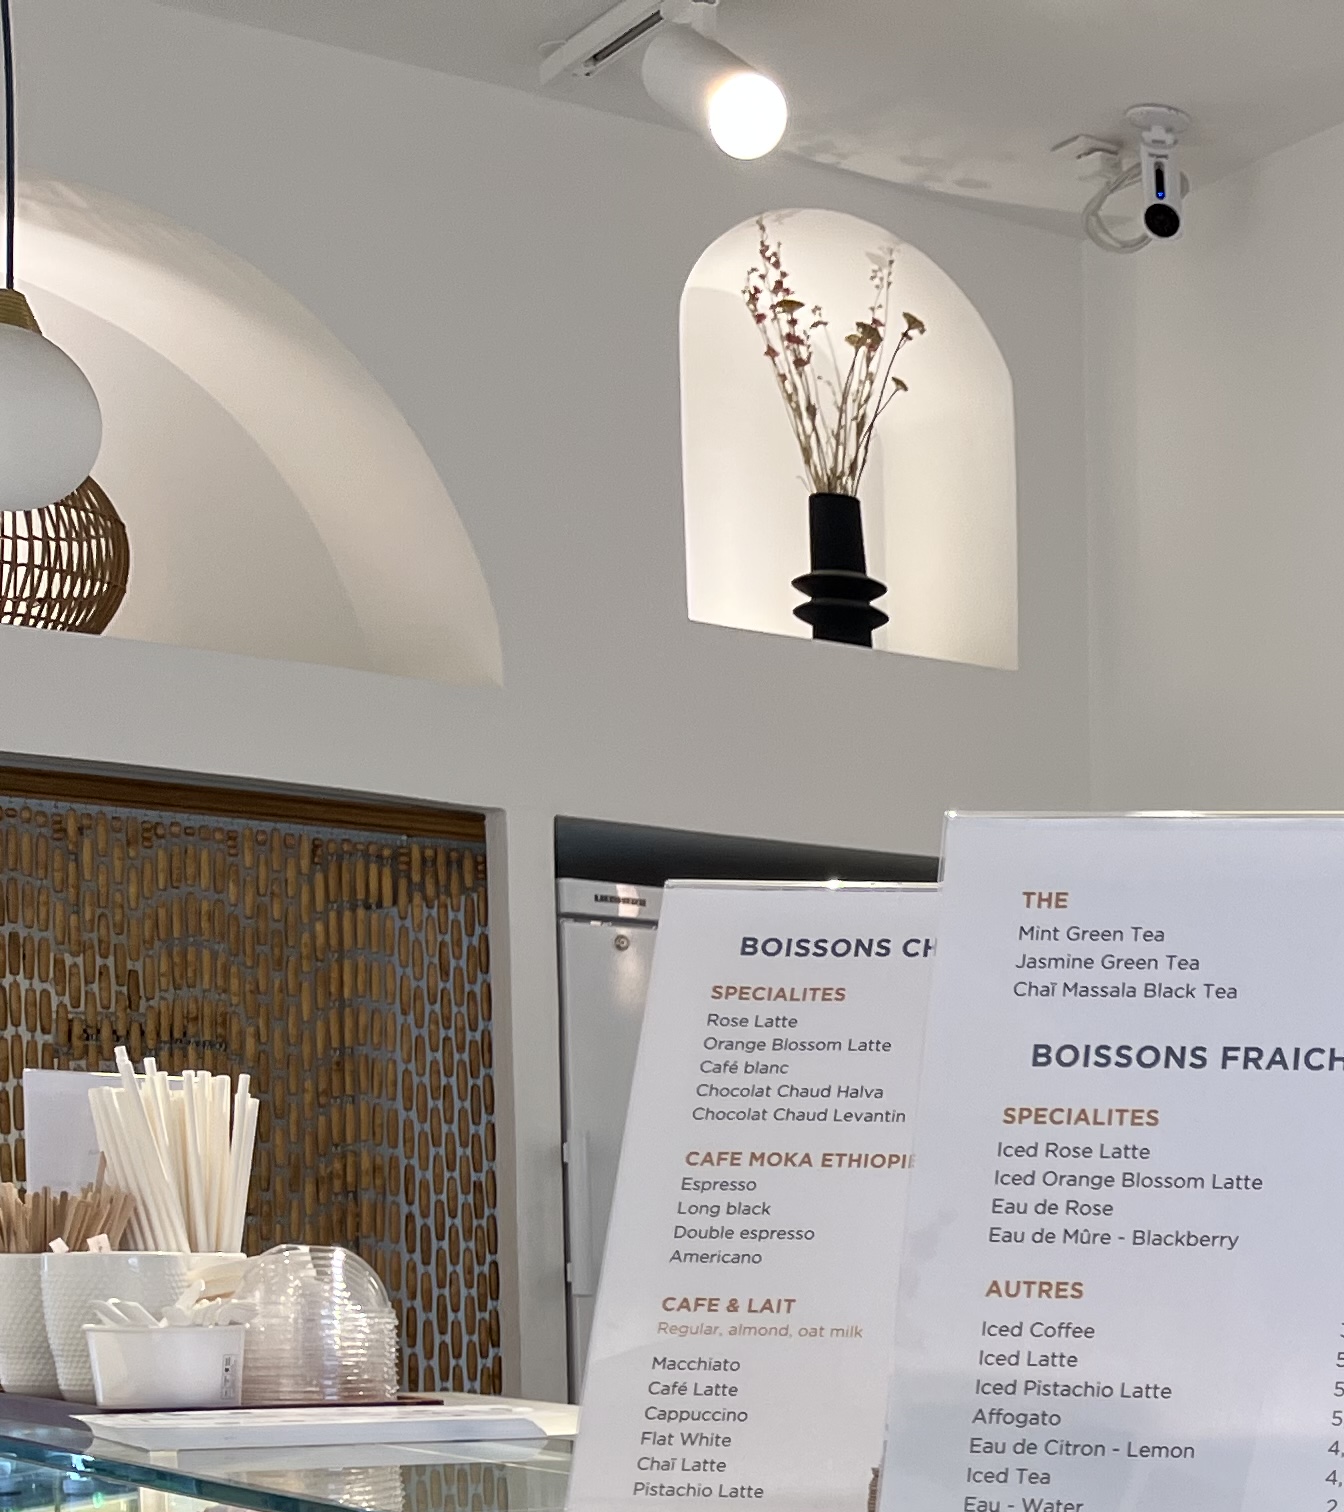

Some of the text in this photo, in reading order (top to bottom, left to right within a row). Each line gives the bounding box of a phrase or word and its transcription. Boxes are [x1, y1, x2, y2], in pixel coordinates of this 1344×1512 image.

[1021, 891, 1069, 909] THE
[1018, 925, 1060, 942] Mint
[1065, 925, 1124, 942] Green
[1130, 926, 1165, 943] Tea
[739, 936, 892, 958] BOISSONS
[1015, 953, 1095, 970] Jasmine
[1100, 953, 1159, 971] Green
[1165, 954, 1200, 971] Tea
[710, 984, 846, 1002] SPECIALITES
[1062, 981, 1137, 999] Massala
[1143, 982, 1197, 999] Black
[1203, 982, 1238, 1000] Tea
[706, 1012, 799, 1029] Rose Latte
[703, 1036, 892, 1054] Orange Blossom Latte
[1031, 1043, 1208, 1070] BOISSONS
[699, 1059, 790, 1075] Café blanc
[695, 1083, 884, 1100] Chocolat Chaud Halva
[1002, 1106, 1160, 1127] SPECIALITES
[685, 1150, 743, 1167] CAFE
[748, 1151, 813, 1168] MOKA
[997, 1141, 1039, 1158] Iced
[1044, 1141, 1094, 1159] Rose
[1099, 1143, 1151, 1160] Latte
[680, 1176, 758, 1194] Espresso
[994, 1169, 1036, 1187] Iced
[1041, 1170, 1116, 1191] Orange
[1121, 1171, 1205, 1189] Blossom
[1211, 1173, 1264, 1191] Latte
[676, 1201, 771, 1219] Long black
[991, 1197, 1028, 1215] Eau
[1033, 1198, 1059, 1216] de
[1065, 1199, 1114, 1217] Rose
[668, 1249, 763, 1265] Americano
[984, 1279, 1084, 1300] AUTRES
[661, 1296, 797, 1314] CAFE & LAIT
[981, 1320, 1024, 1338] Iced
[1029, 1321, 1096, 1340] Coffee
[651, 1356, 741, 1372] Macchiato
[978, 1349, 1021, 1367] Iced
[1026, 1350, 1079, 1368] Latte
[644, 1405, 749, 1424] Cappuccino
[971, 1407, 1062, 1429] Affogato
[640, 1430, 732, 1448] Flat White
[680, 1457, 727, 1473] Latte
[966, 1466, 1010, 1484] Iced
[1015, 1467, 1051, 1485] Tea
[632, 1481, 765, 1499] Pistachio Latte
